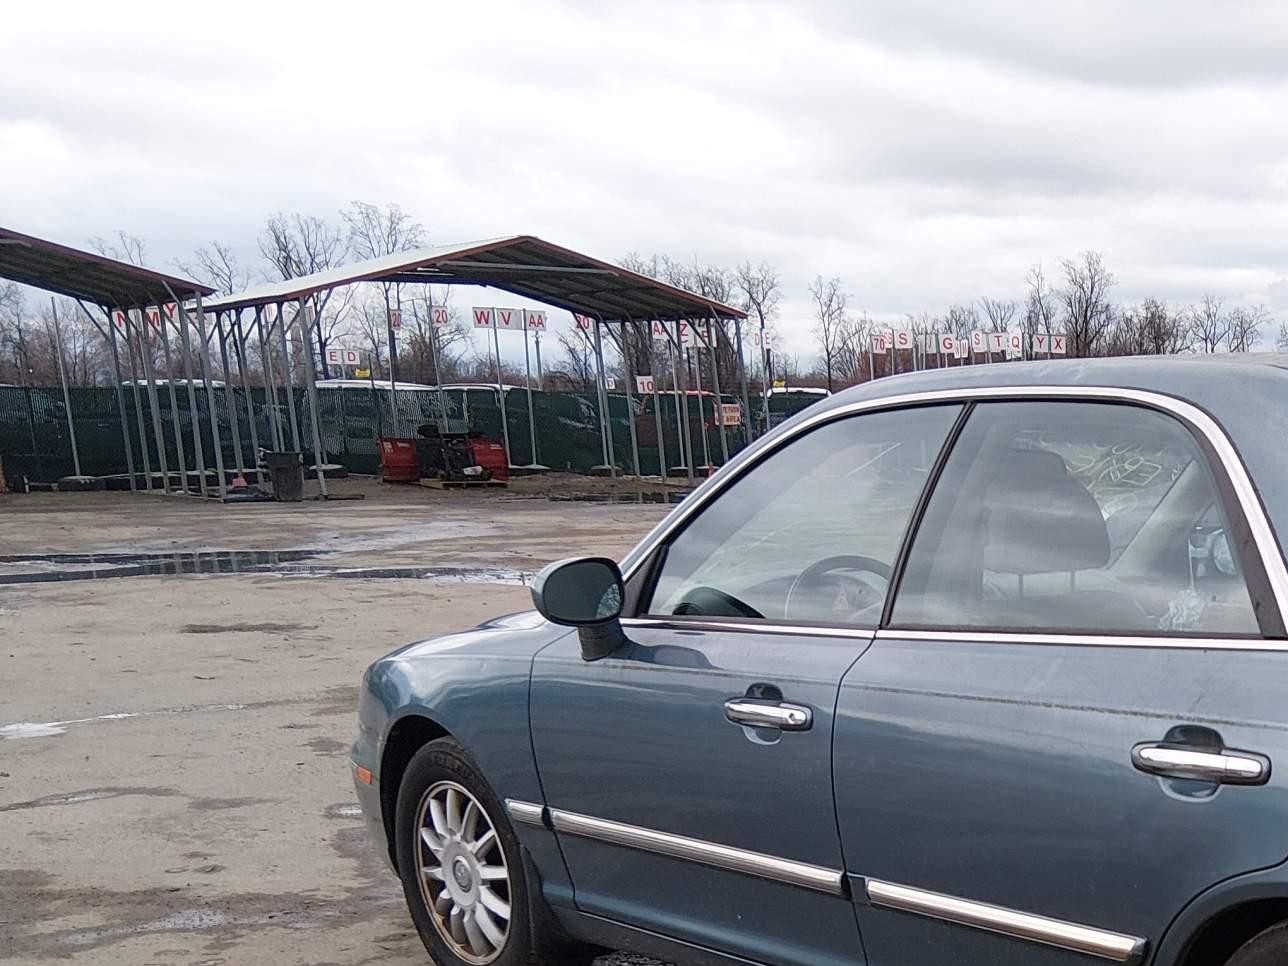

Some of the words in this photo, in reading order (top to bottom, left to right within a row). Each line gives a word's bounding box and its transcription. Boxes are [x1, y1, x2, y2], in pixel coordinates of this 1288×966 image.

[392, 312, 402, 328] 20
[434, 309, 448, 324] 20
[473, 310, 490, 325] W
[500, 311, 512, 326] V
[528, 313, 545, 328] AA
[873, 338, 885, 351] 70
[898, 332, 908, 346] S
[942, 336, 953, 350] G
[974, 332, 981, 346] S
[993, 335, 1003, 348] T
[1011, 335, 1021, 349] Q
[1036, 336, 1045, 350] Y
[1054, 337, 1063, 351] X
[329, 351, 338, 362] E
[347, 351, 357, 362] D
[639, 381, 655, 393] 10
